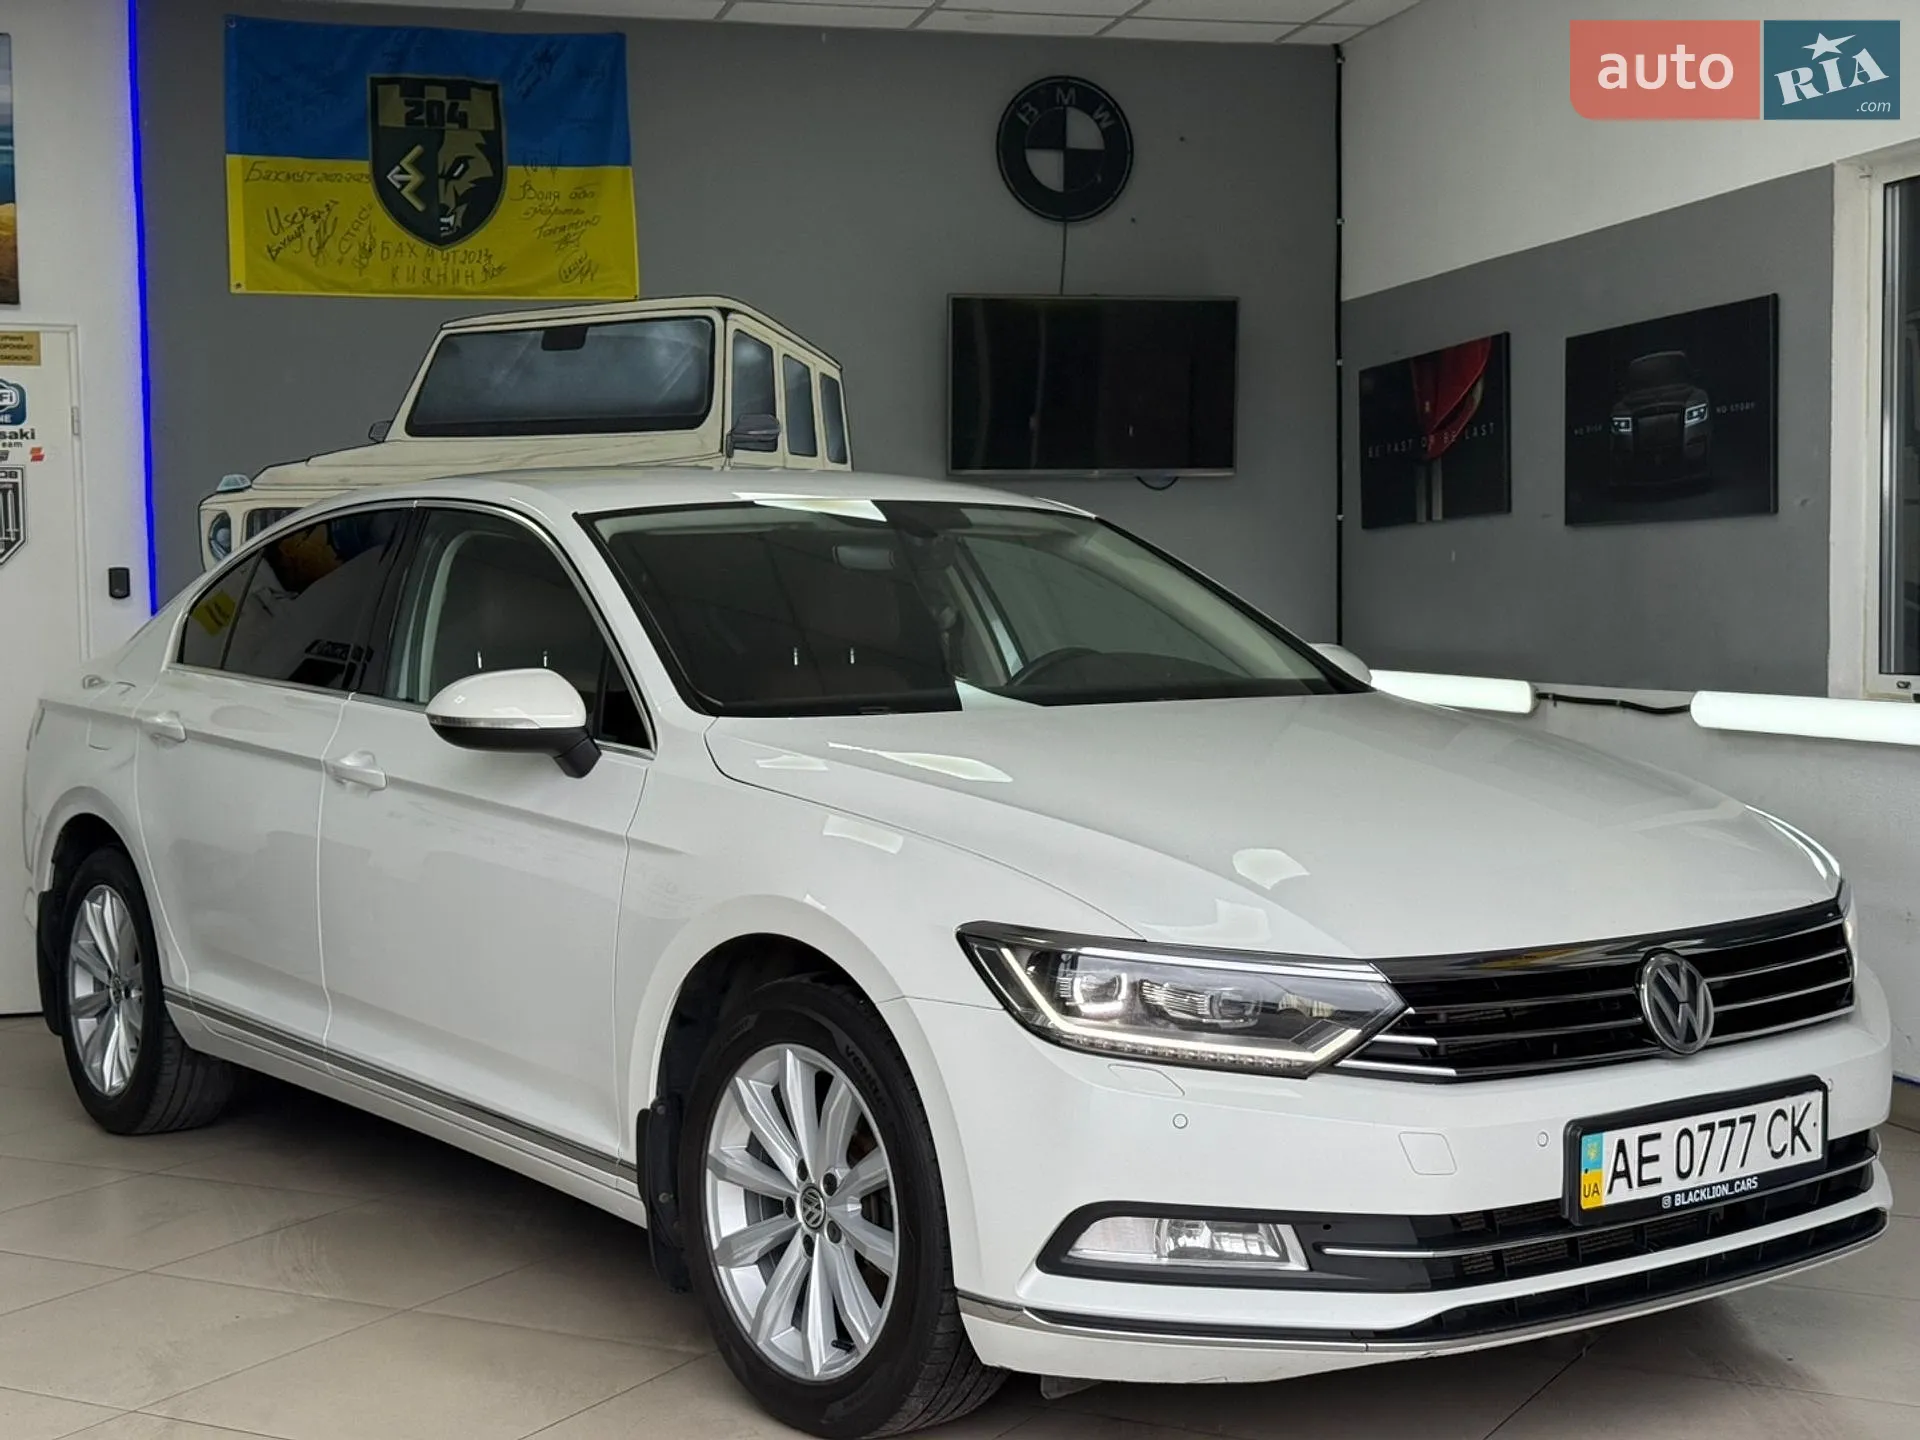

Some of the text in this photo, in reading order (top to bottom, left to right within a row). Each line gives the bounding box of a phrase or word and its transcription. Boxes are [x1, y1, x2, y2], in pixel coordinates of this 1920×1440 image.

[404, 100, 468, 129] 204
[1016, 87, 1116, 130] BMW
[1465, 422, 1495, 440] LAST
[1582, 1101, 1812, 1200] UA AE 0777 CK
[1674, 1177, 1759, 1206] BLACKLION_CARS
